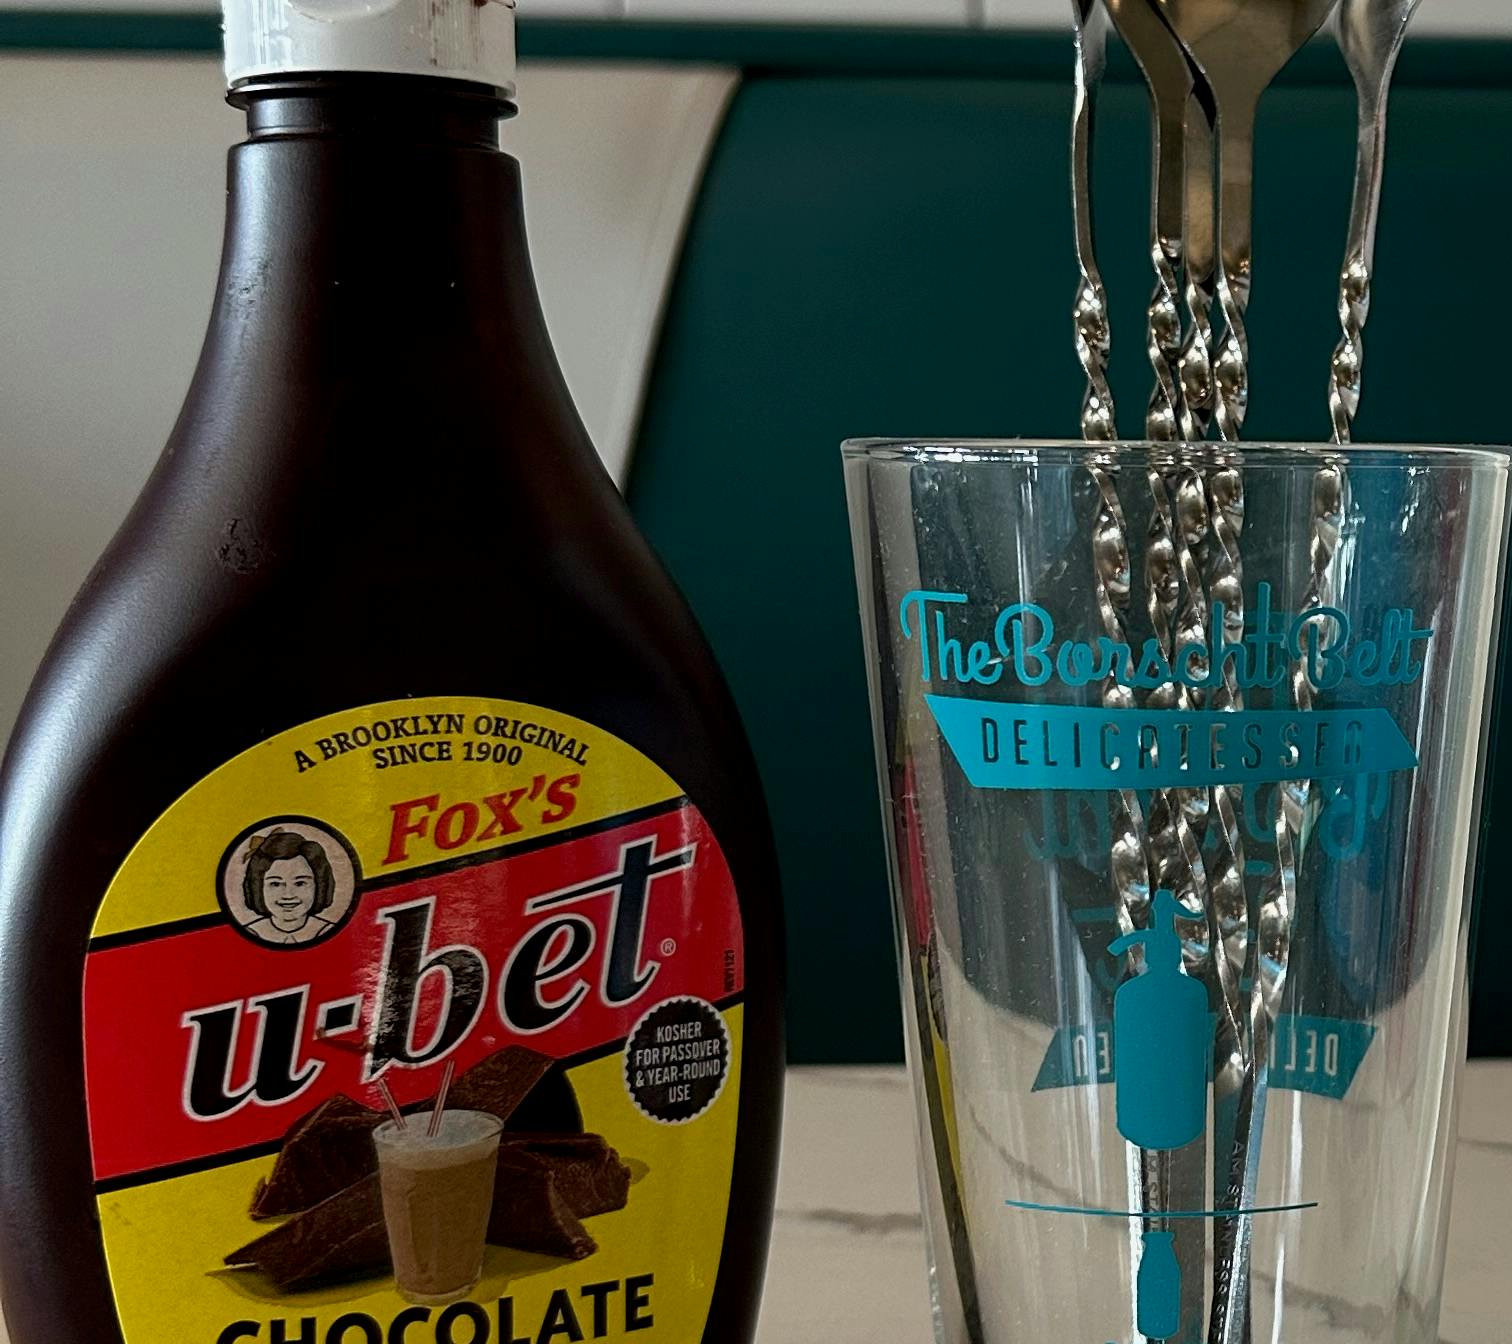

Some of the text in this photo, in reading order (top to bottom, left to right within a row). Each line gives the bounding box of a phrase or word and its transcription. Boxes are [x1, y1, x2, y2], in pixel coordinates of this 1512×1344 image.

[900, 582, 1434, 689] The Borscht Belt
[293, 713, 590, 773] A BROOKLYN ORIGINAL
[372, 741, 523, 769] SINCE 1900
[981, 717, 1363, 770] DELICATESSEN
[656, 1021, 702, 1044] KOSHER
[636, 1039, 720, 1067] FOR PASSOVER
[635, 1059, 721, 1088] & YEAR-ROUND
[668, 1084, 692, 1104] USE
